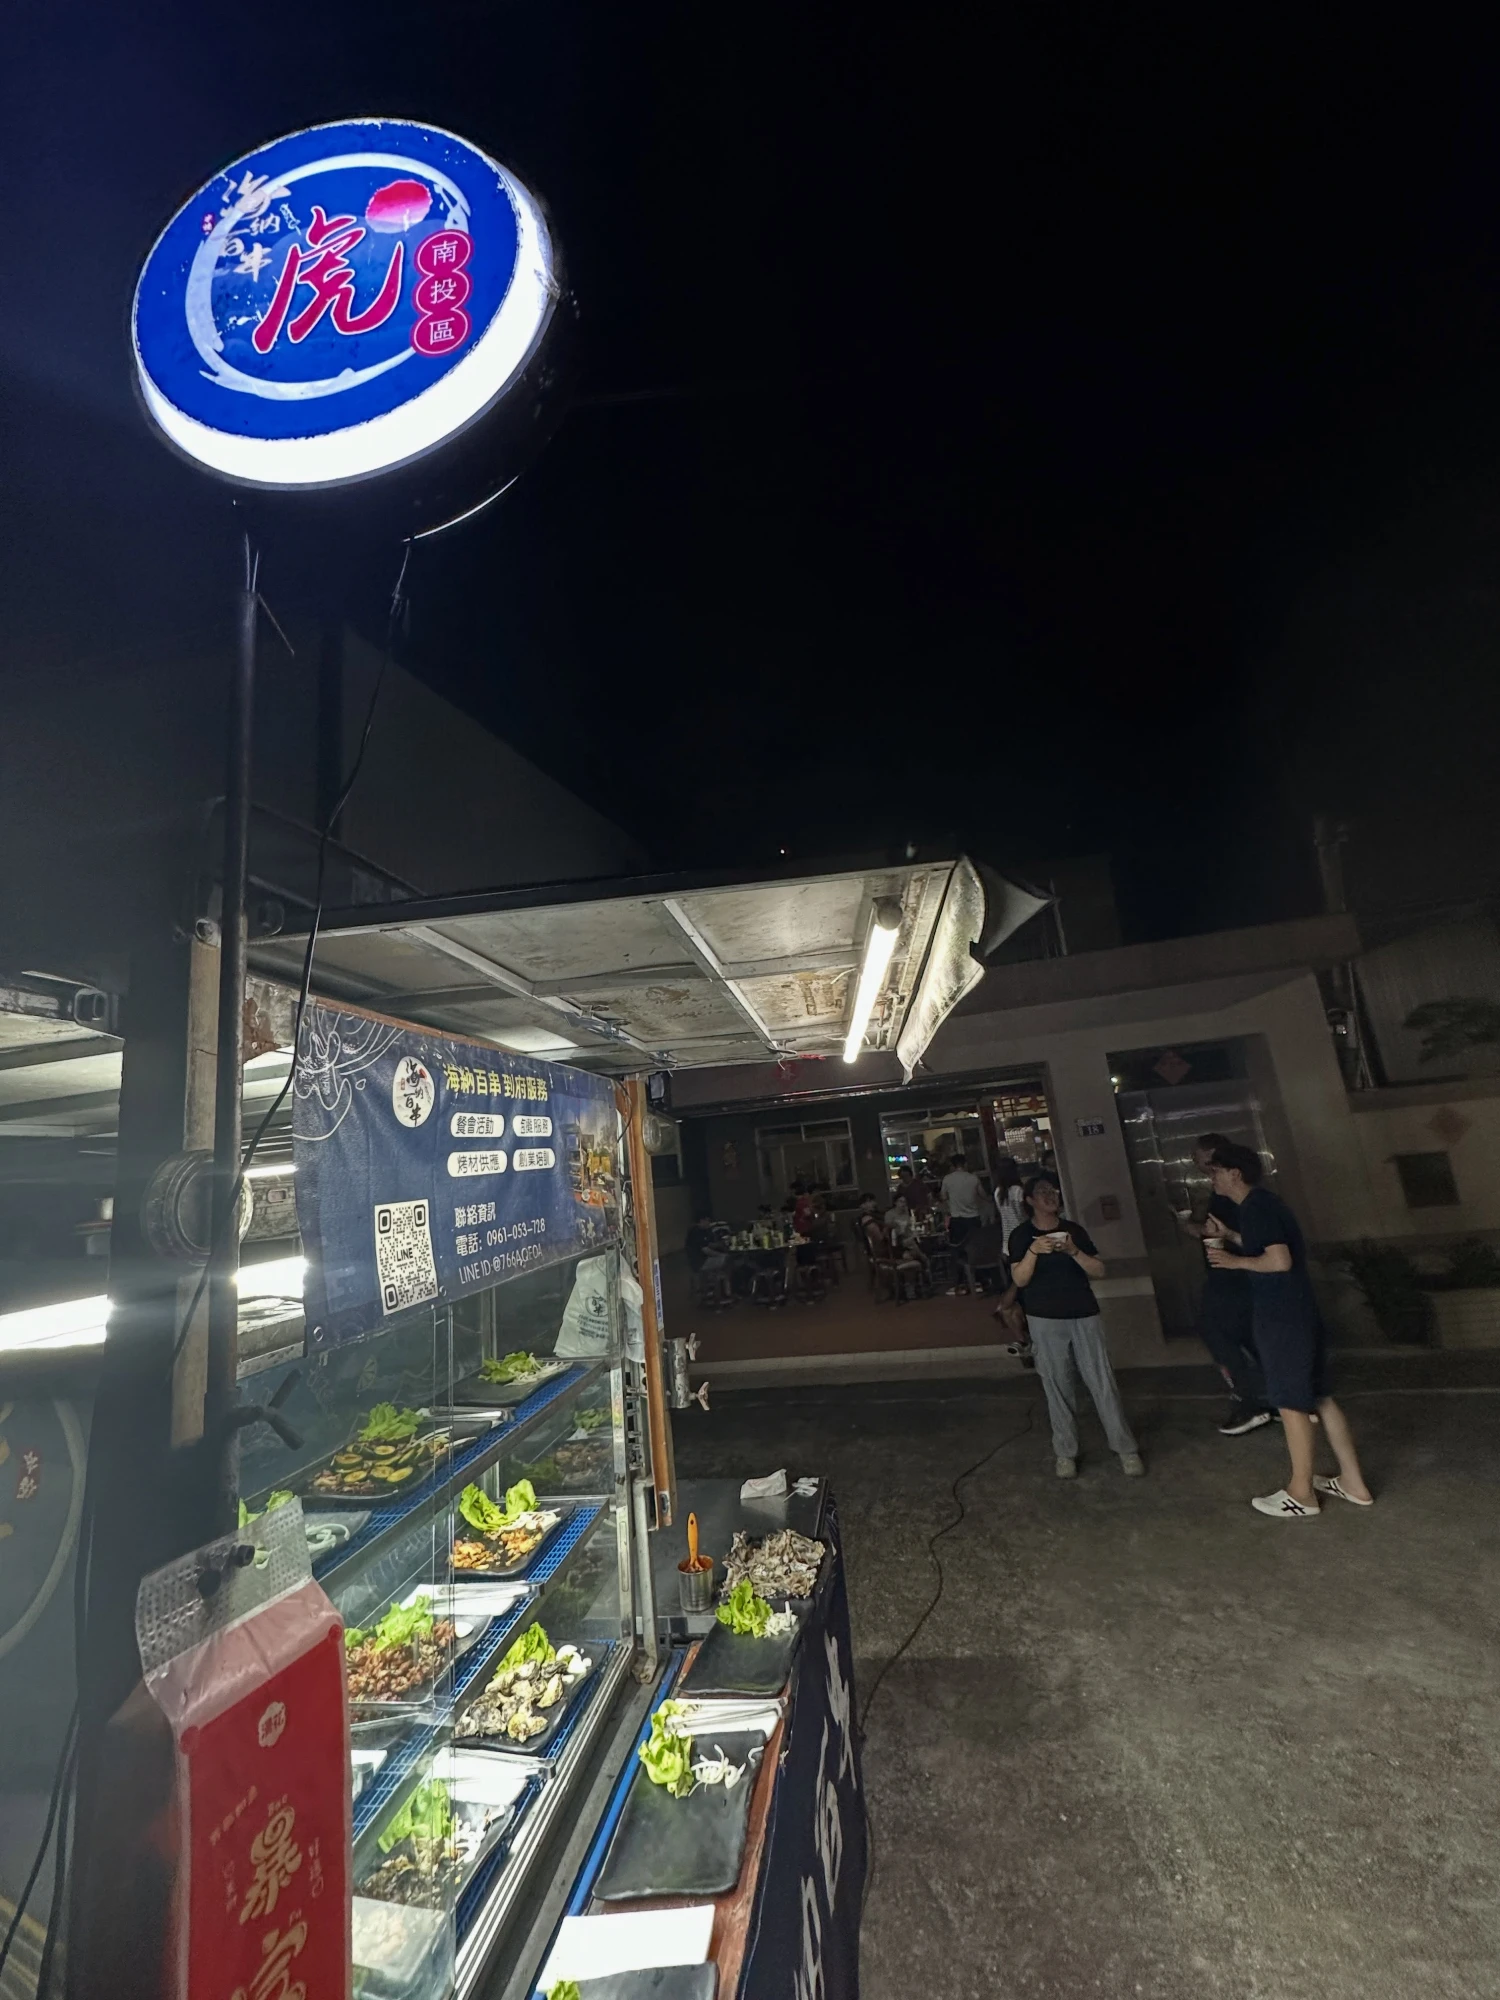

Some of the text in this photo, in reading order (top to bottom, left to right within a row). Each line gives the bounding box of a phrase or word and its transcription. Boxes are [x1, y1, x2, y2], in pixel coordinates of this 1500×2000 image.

[252, 205, 404, 354] 虎
[428, 239, 459, 346] 南投區
[442, 1063, 502, 1097] 海納百串
[502, 1073, 549, 1102] 到府服務
[455, 1115, 494, 1136] 餐會活動
[454, 1201, 497, 1229] 聯絡資訊
[486, 1217, 546, 1247] 0961-053-728
[396, 1248, 414, 1262] LINE
[458, 1262, 481, 1285] LINE
